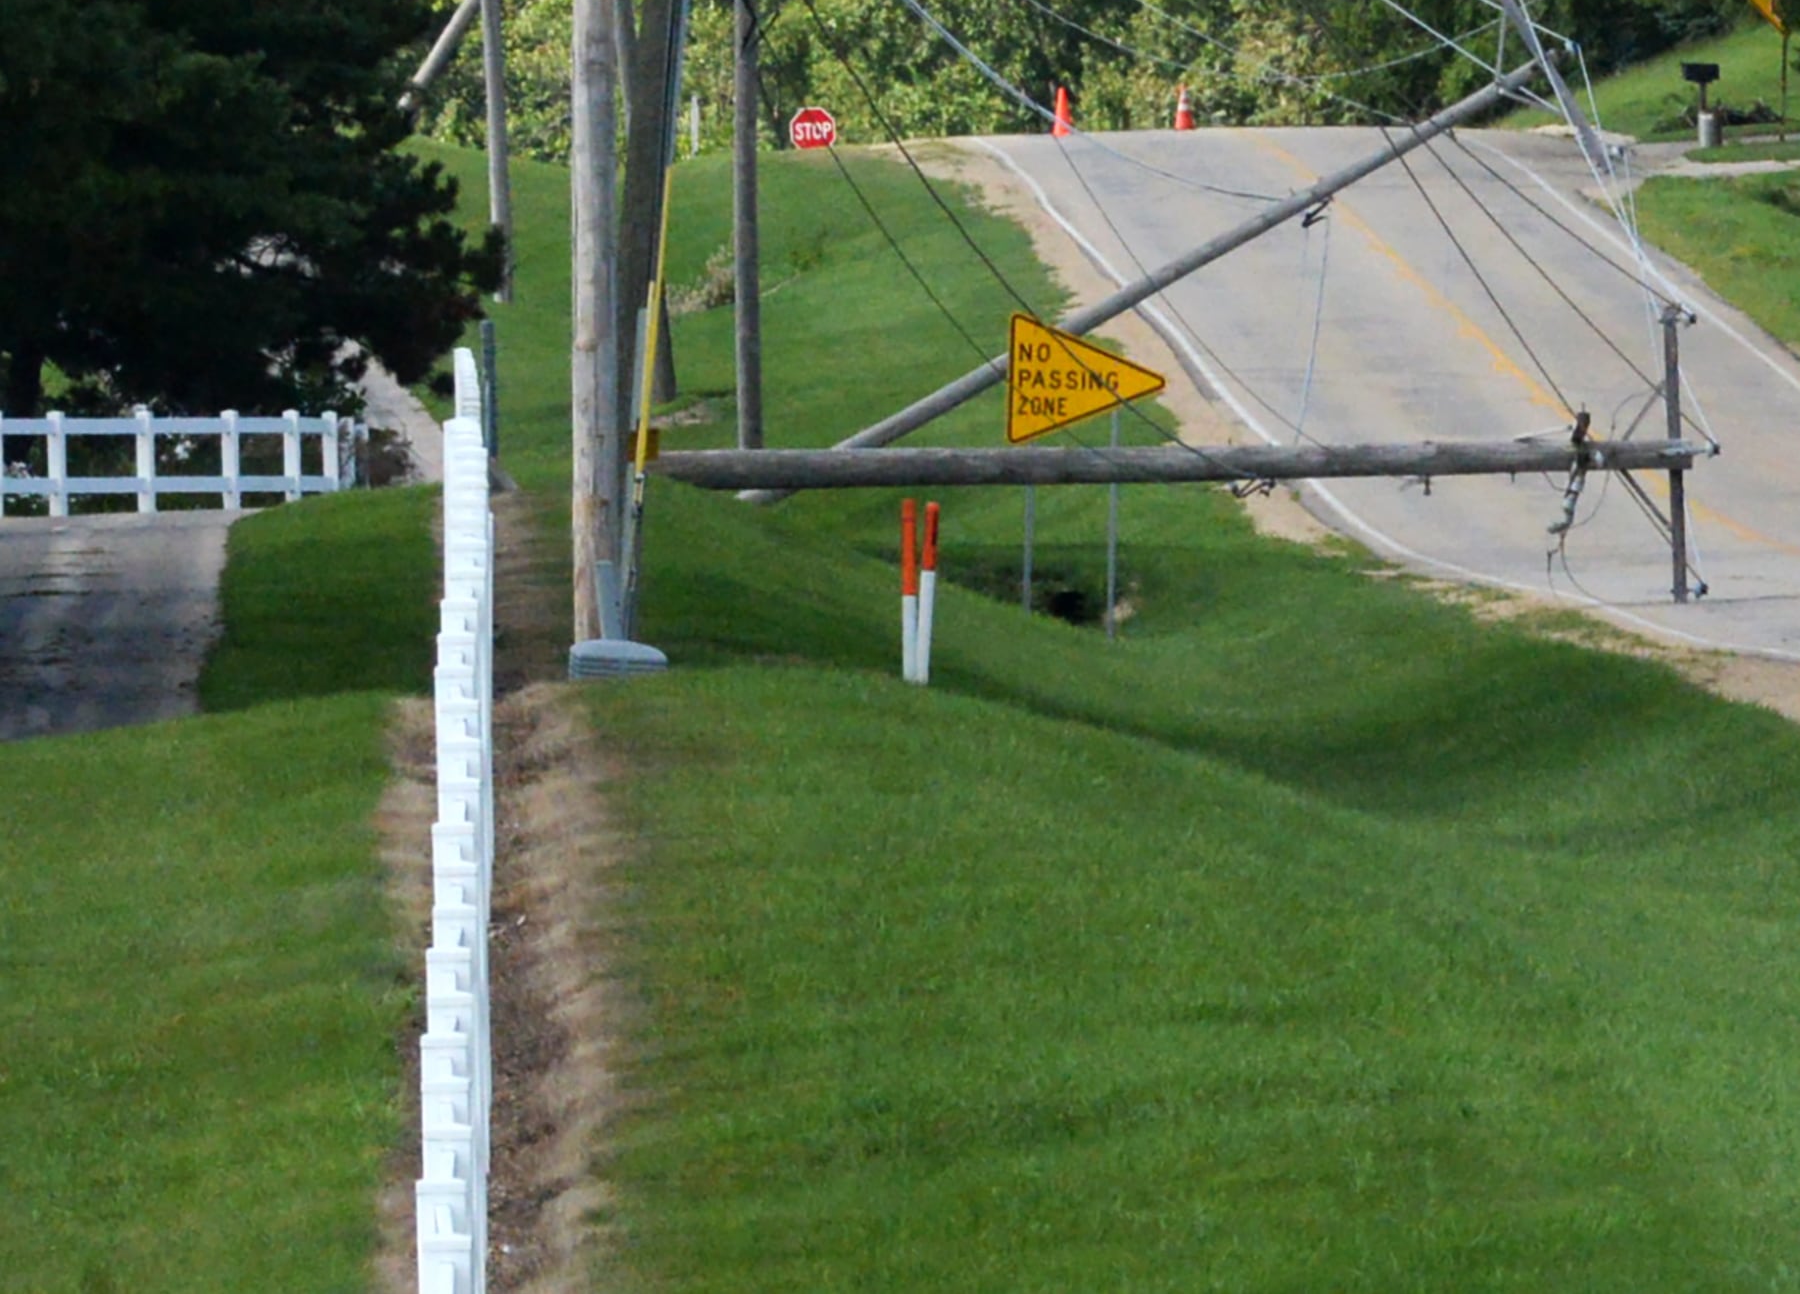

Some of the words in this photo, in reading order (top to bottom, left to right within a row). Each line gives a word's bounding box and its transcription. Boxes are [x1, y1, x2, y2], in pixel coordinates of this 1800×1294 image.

[795, 121, 832, 141] STOP
[1018, 343, 1051, 362] NO
[1018, 370, 1119, 391] PASSING
[1018, 397, 1068, 416] ZONE
